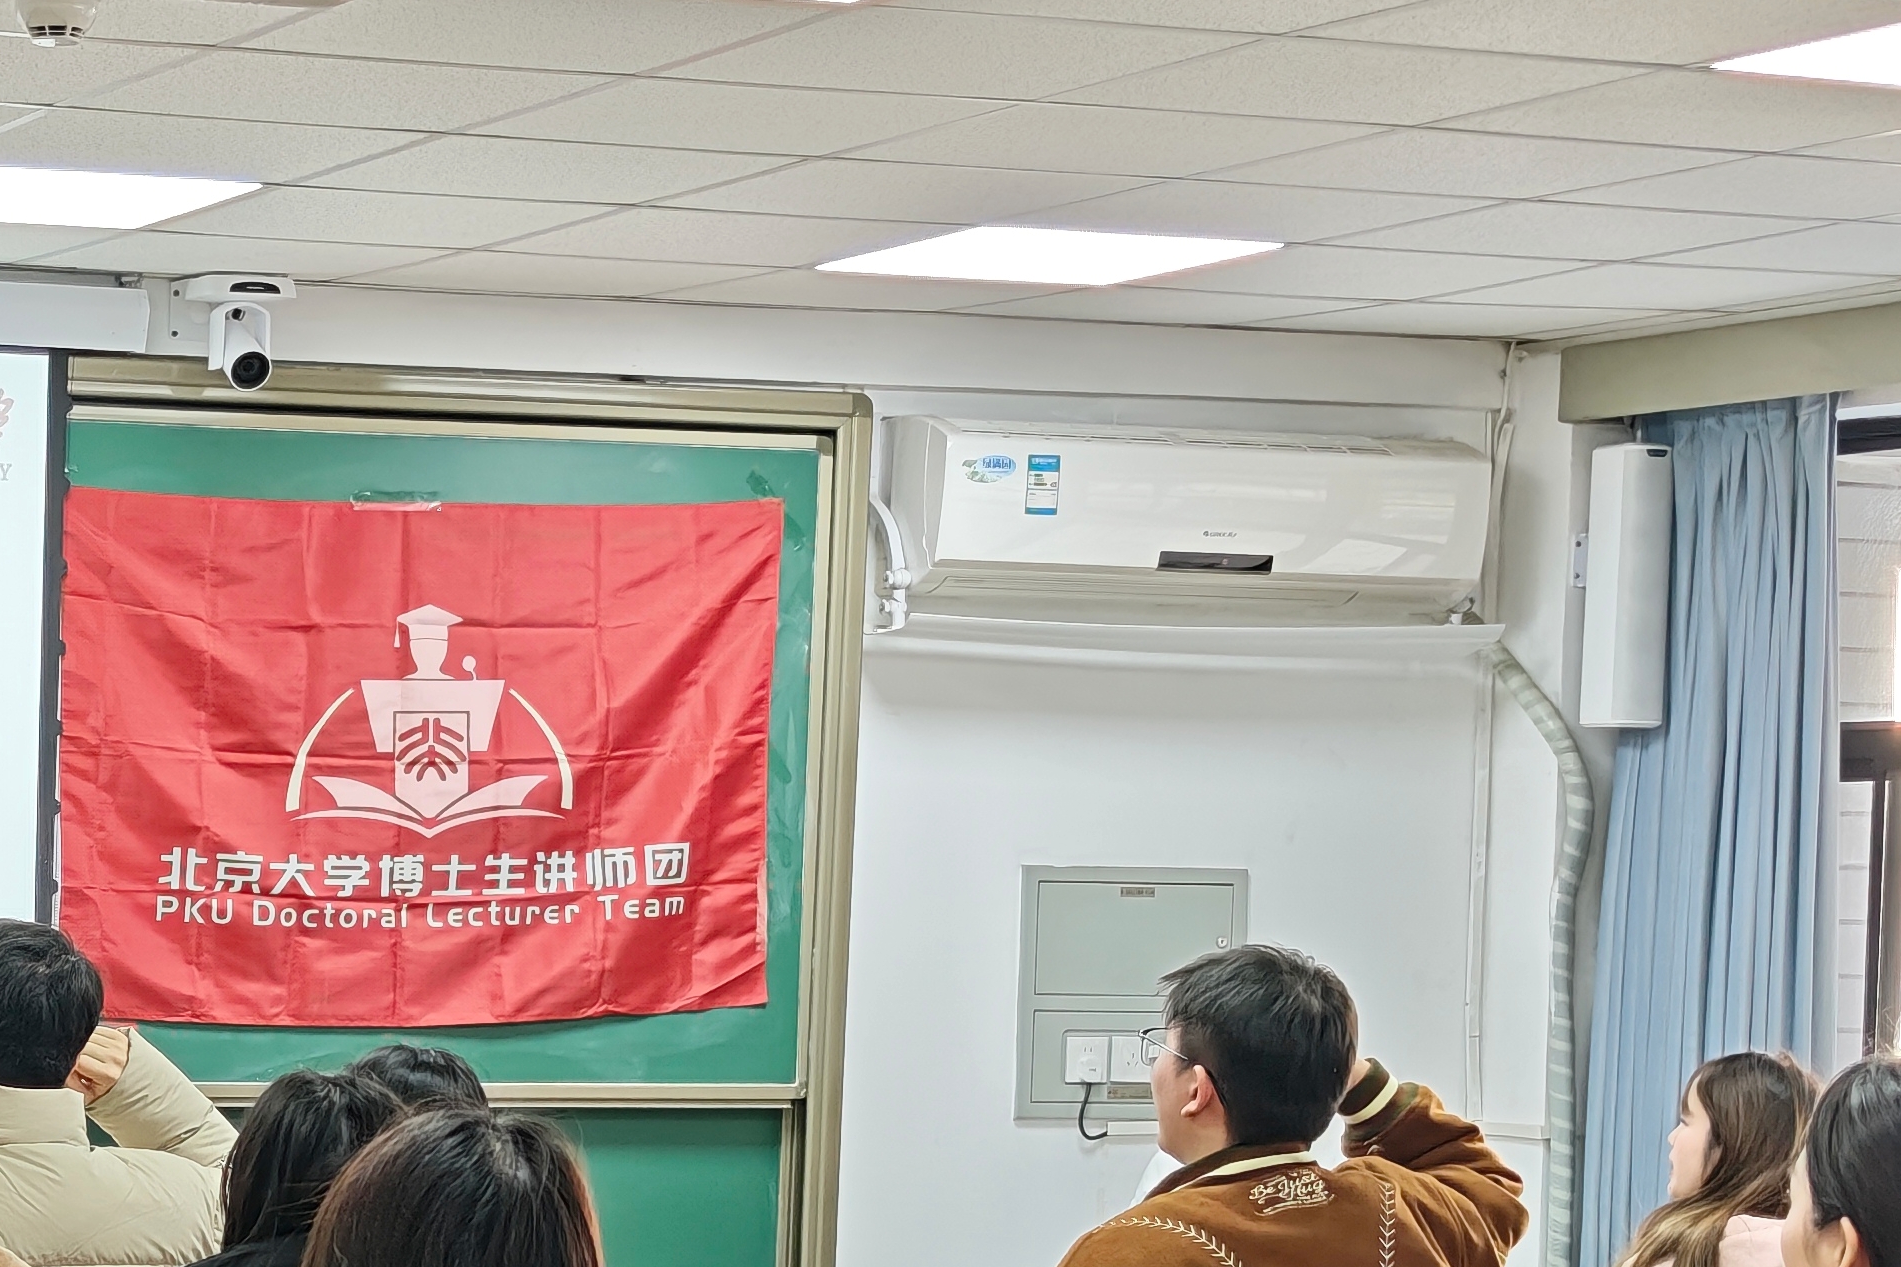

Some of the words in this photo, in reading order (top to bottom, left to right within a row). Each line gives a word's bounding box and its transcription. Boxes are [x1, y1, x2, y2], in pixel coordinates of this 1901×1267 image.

[157, 842, 691, 899] 北京大学博士生讲师团
[155, 895, 233, 925] PKU
[252, 898, 409, 930] Doctoral
[426, 900, 580, 928] Lecturer
[596, 893, 685, 921] Team
[1249, 1184, 1276, 1200] Be
